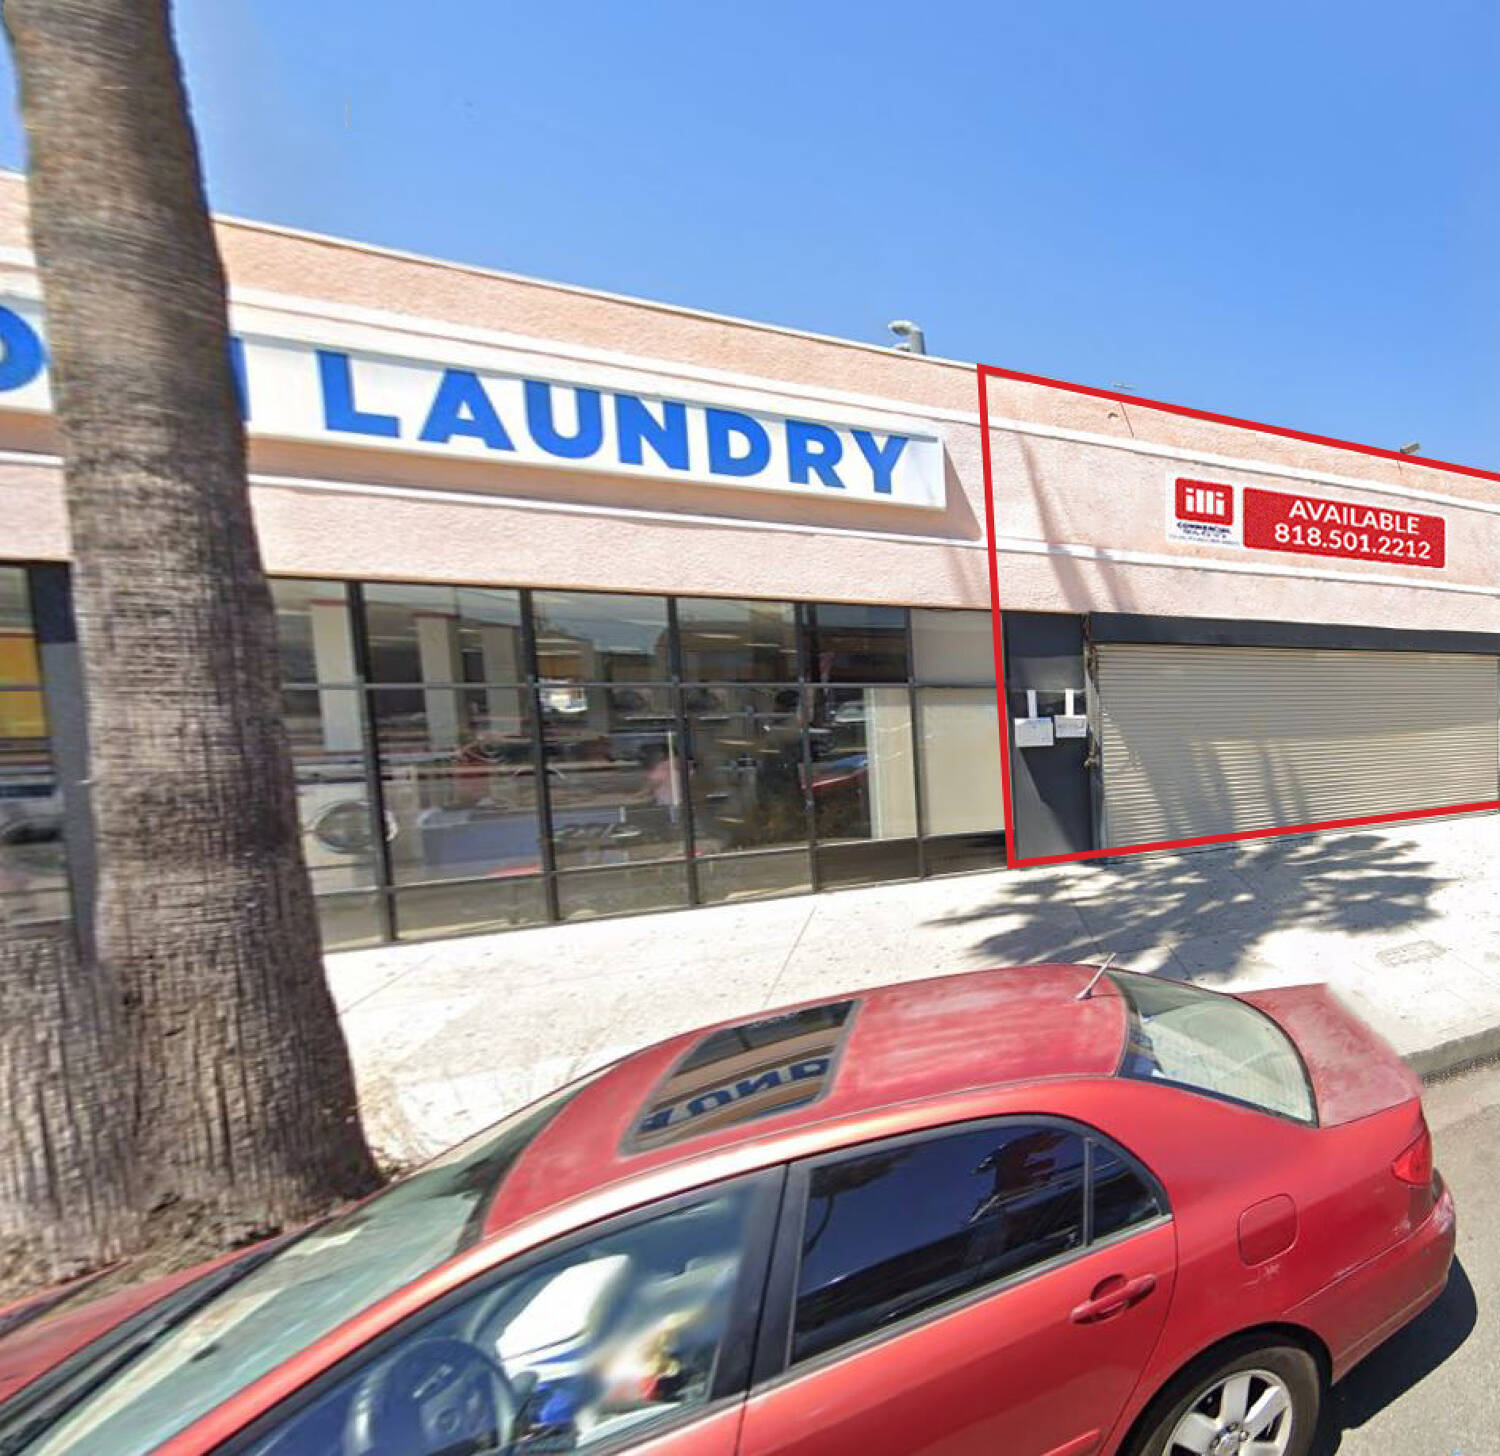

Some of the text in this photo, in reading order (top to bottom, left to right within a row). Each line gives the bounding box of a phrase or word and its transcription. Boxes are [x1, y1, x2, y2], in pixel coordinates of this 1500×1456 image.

[315, 350, 910, 495] LAUNDRY
[1185, 487, 1225, 517] illi
[1289, 500, 1420, 535] AVAILABLE
[1274, 522, 1431, 560] 818.501.2212
